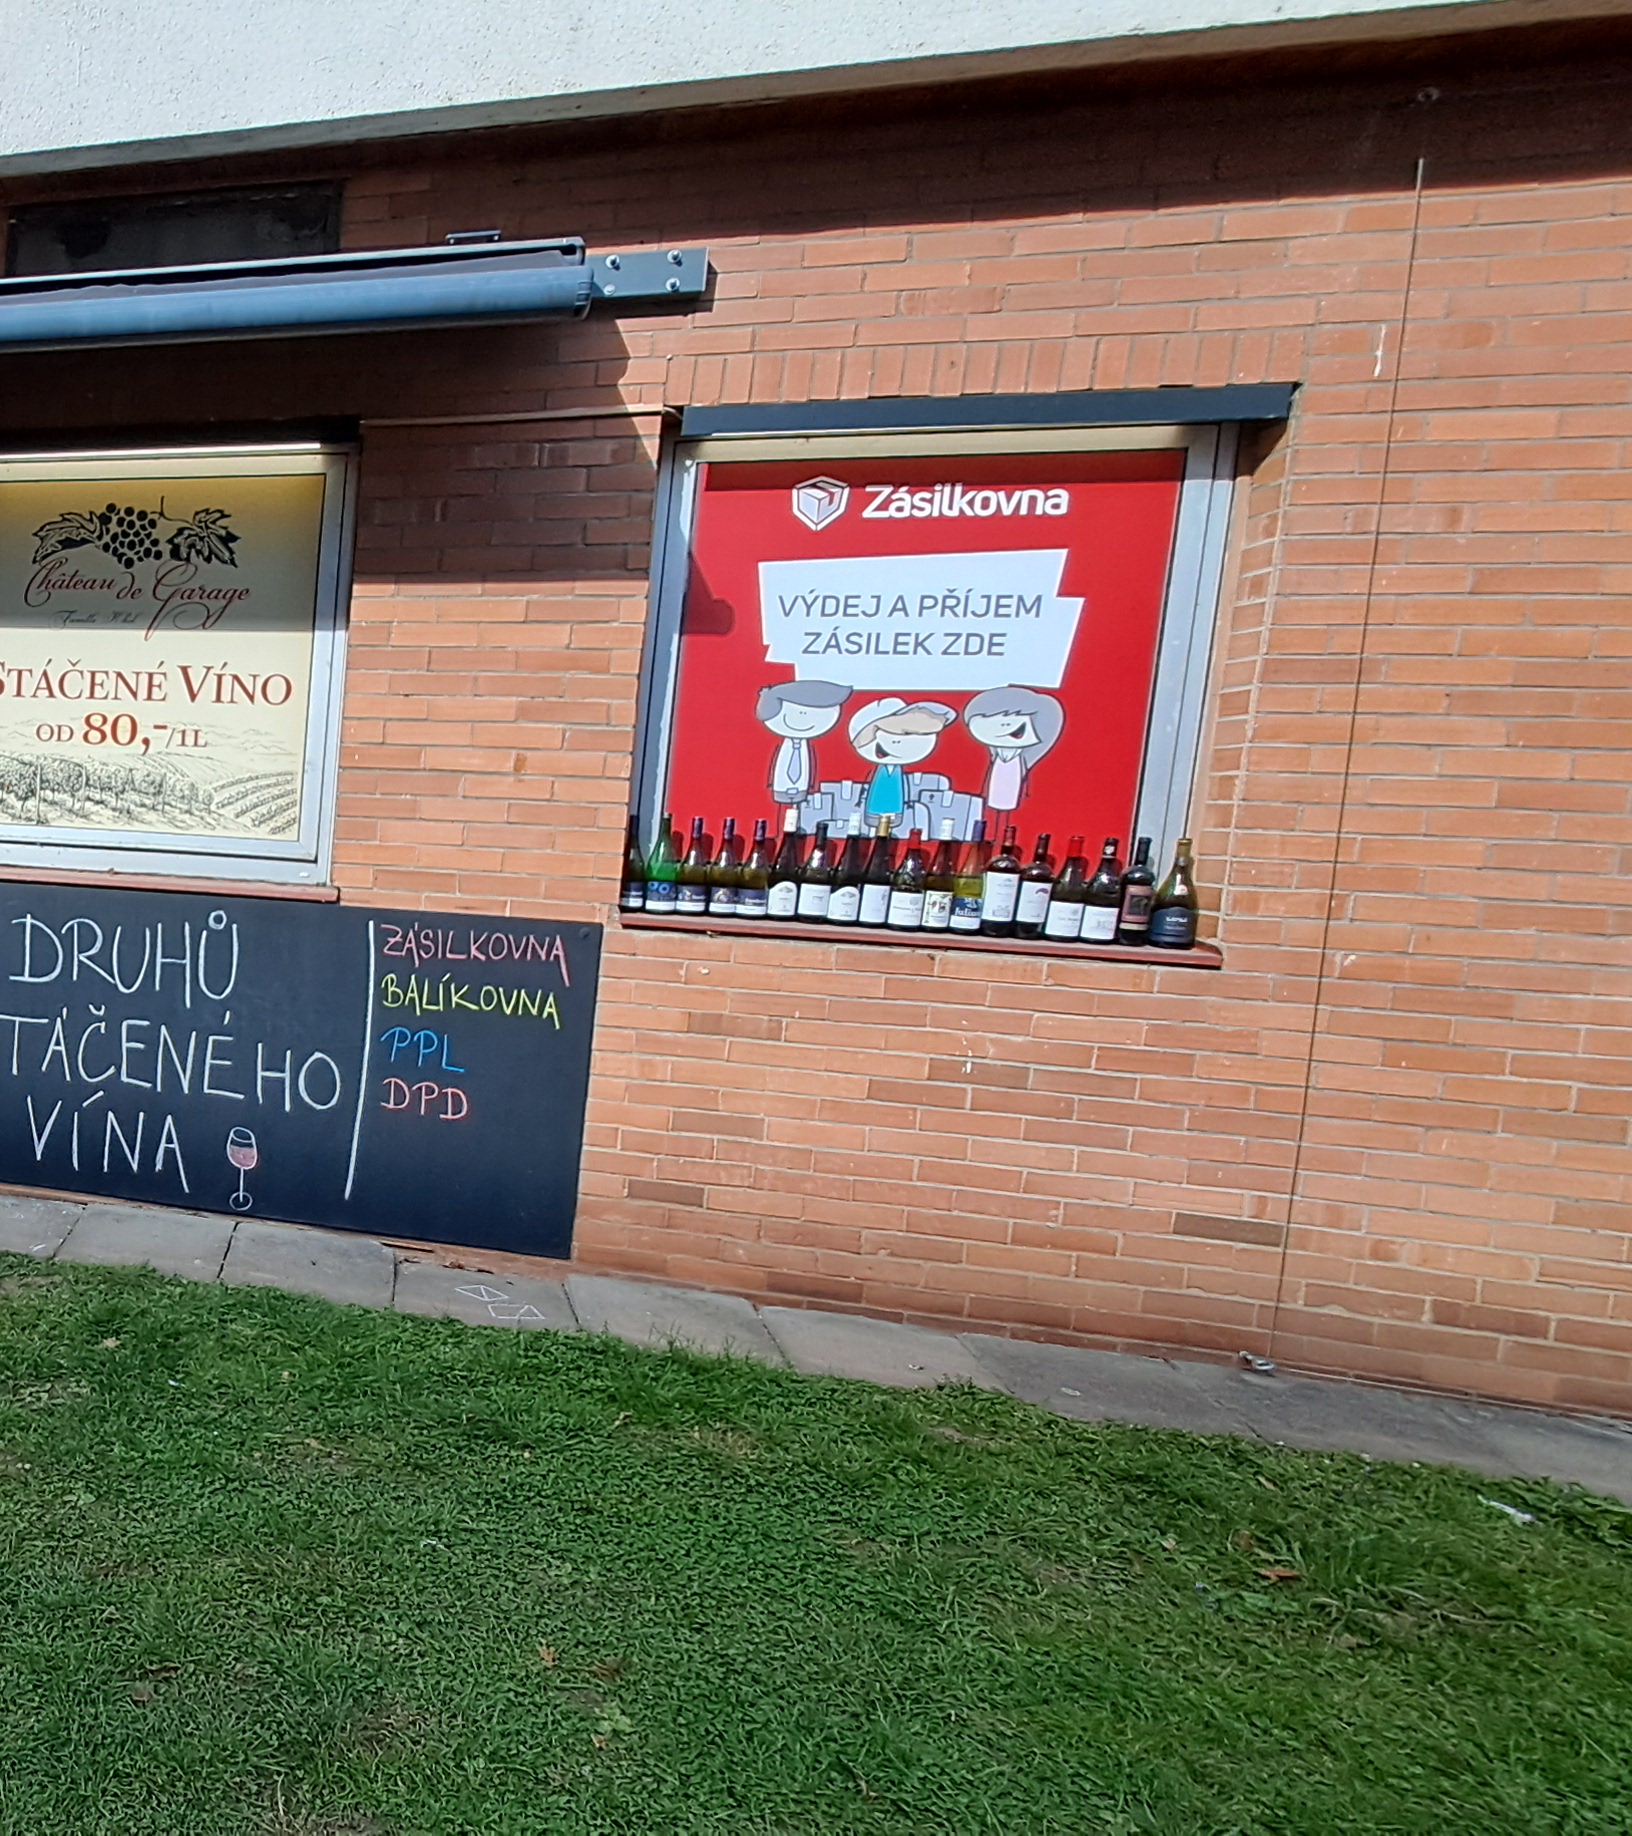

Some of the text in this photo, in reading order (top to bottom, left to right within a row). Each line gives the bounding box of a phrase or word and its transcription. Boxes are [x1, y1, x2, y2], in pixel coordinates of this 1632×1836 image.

[862, 483, 1069, 518] Zásilkovna
[24, 557, 250, 641] Château de Garage
[778, 588, 1044, 618] VÝDEJ A PŘÍJEM
[802, 626, 1008, 656] ZÁSILEK ZDE
[177, 661, 293, 706] VÍNO
[36, 723, 74, 743] OD
[8, 909, 238, 1009] DRUHŮ
[380, 921, 571, 988] ZÁSILKOVNA
[380, 972, 561, 1031] BALÍKOVNA
[380, 1026, 465, 1073] PPL
[380, 1077, 469, 1120] DPD
[26, 1090, 190, 1194] VÍNA
